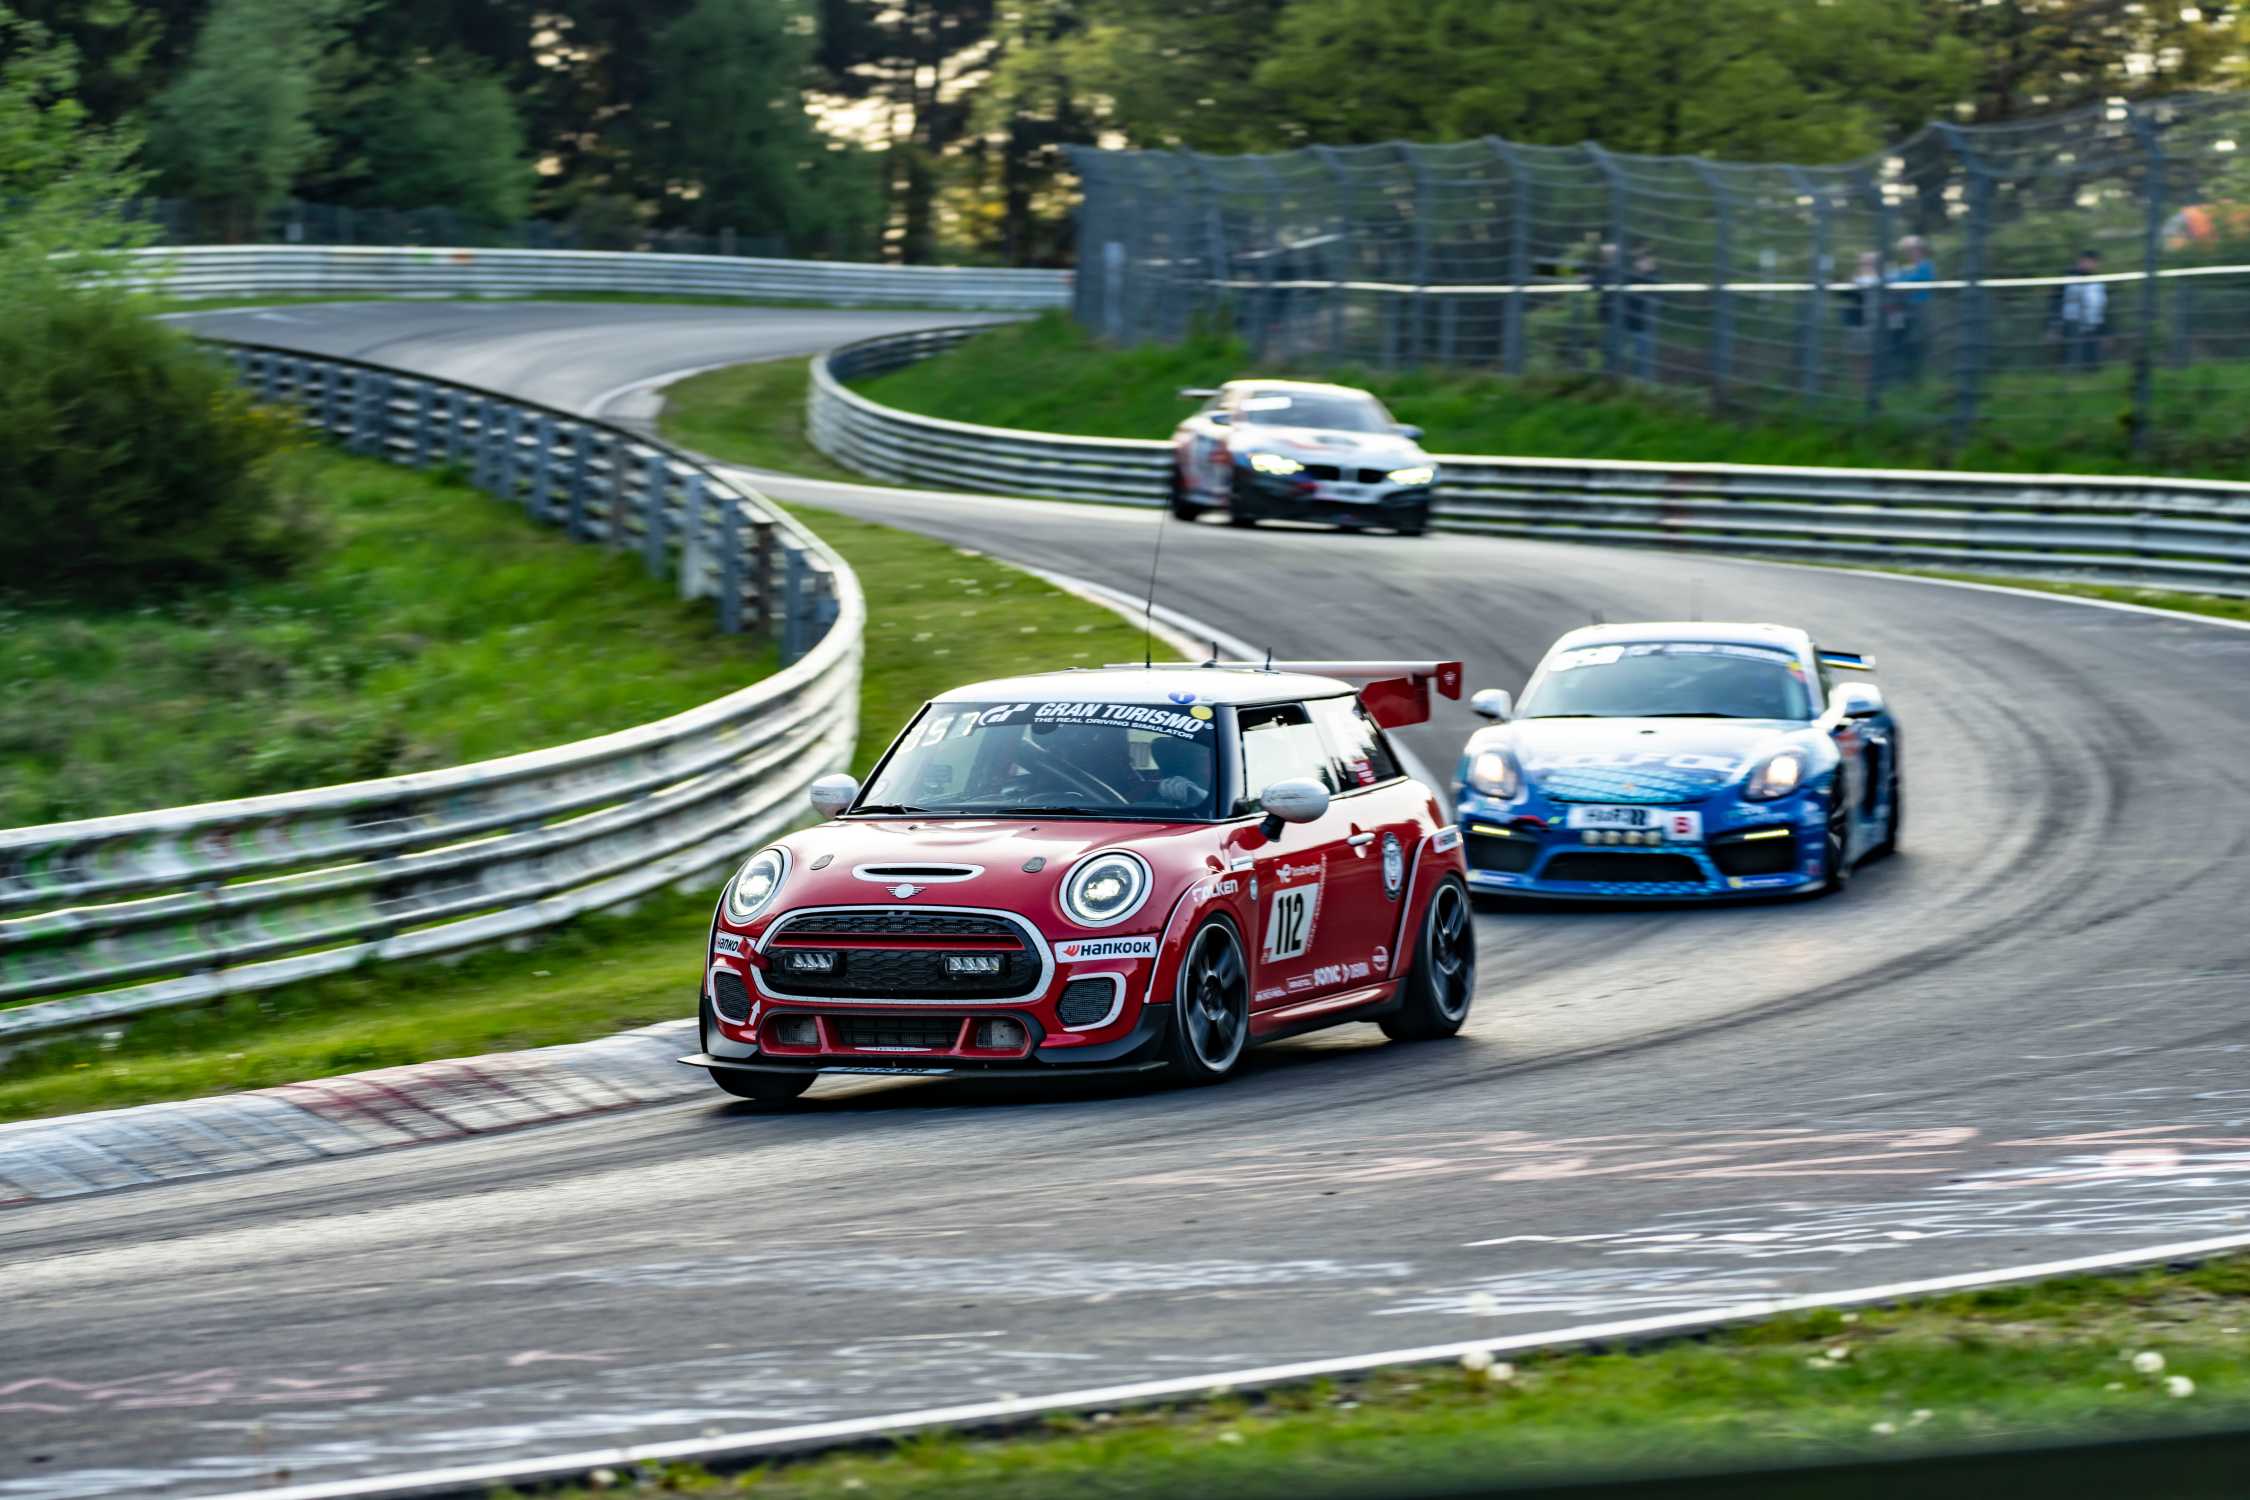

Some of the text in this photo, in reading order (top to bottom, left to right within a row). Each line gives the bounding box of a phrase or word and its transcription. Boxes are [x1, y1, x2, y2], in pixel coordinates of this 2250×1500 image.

[1035, 703, 1103, 717] GRAN
[1101, 704, 1205, 733] TURISMO
[1085, 718, 1129, 727] DRIVING
[1131, 722, 1195, 740] SIMULATOR
[1275, 893, 1304, 955] 112
[1080, 941, 1152, 957] HANKOOK
